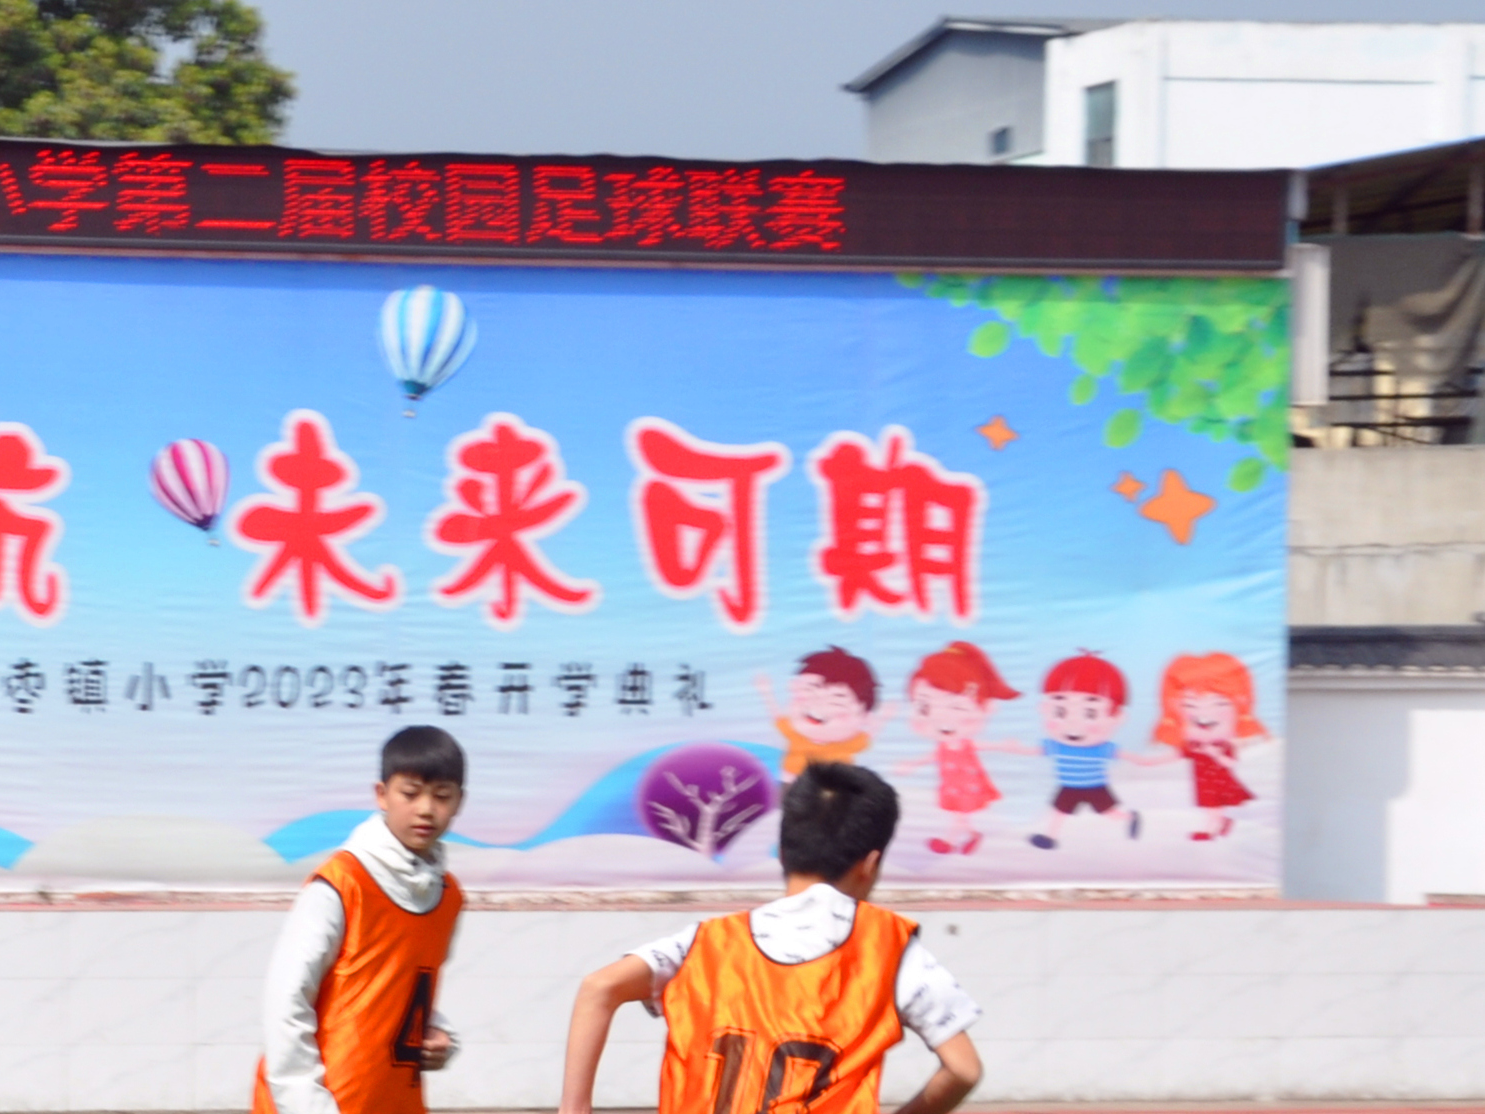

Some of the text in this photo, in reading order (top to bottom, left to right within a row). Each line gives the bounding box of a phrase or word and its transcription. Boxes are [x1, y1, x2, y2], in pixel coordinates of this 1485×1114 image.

[232, 412, 985, 630] 未来可期
[389, 965, 436, 1088] 4
